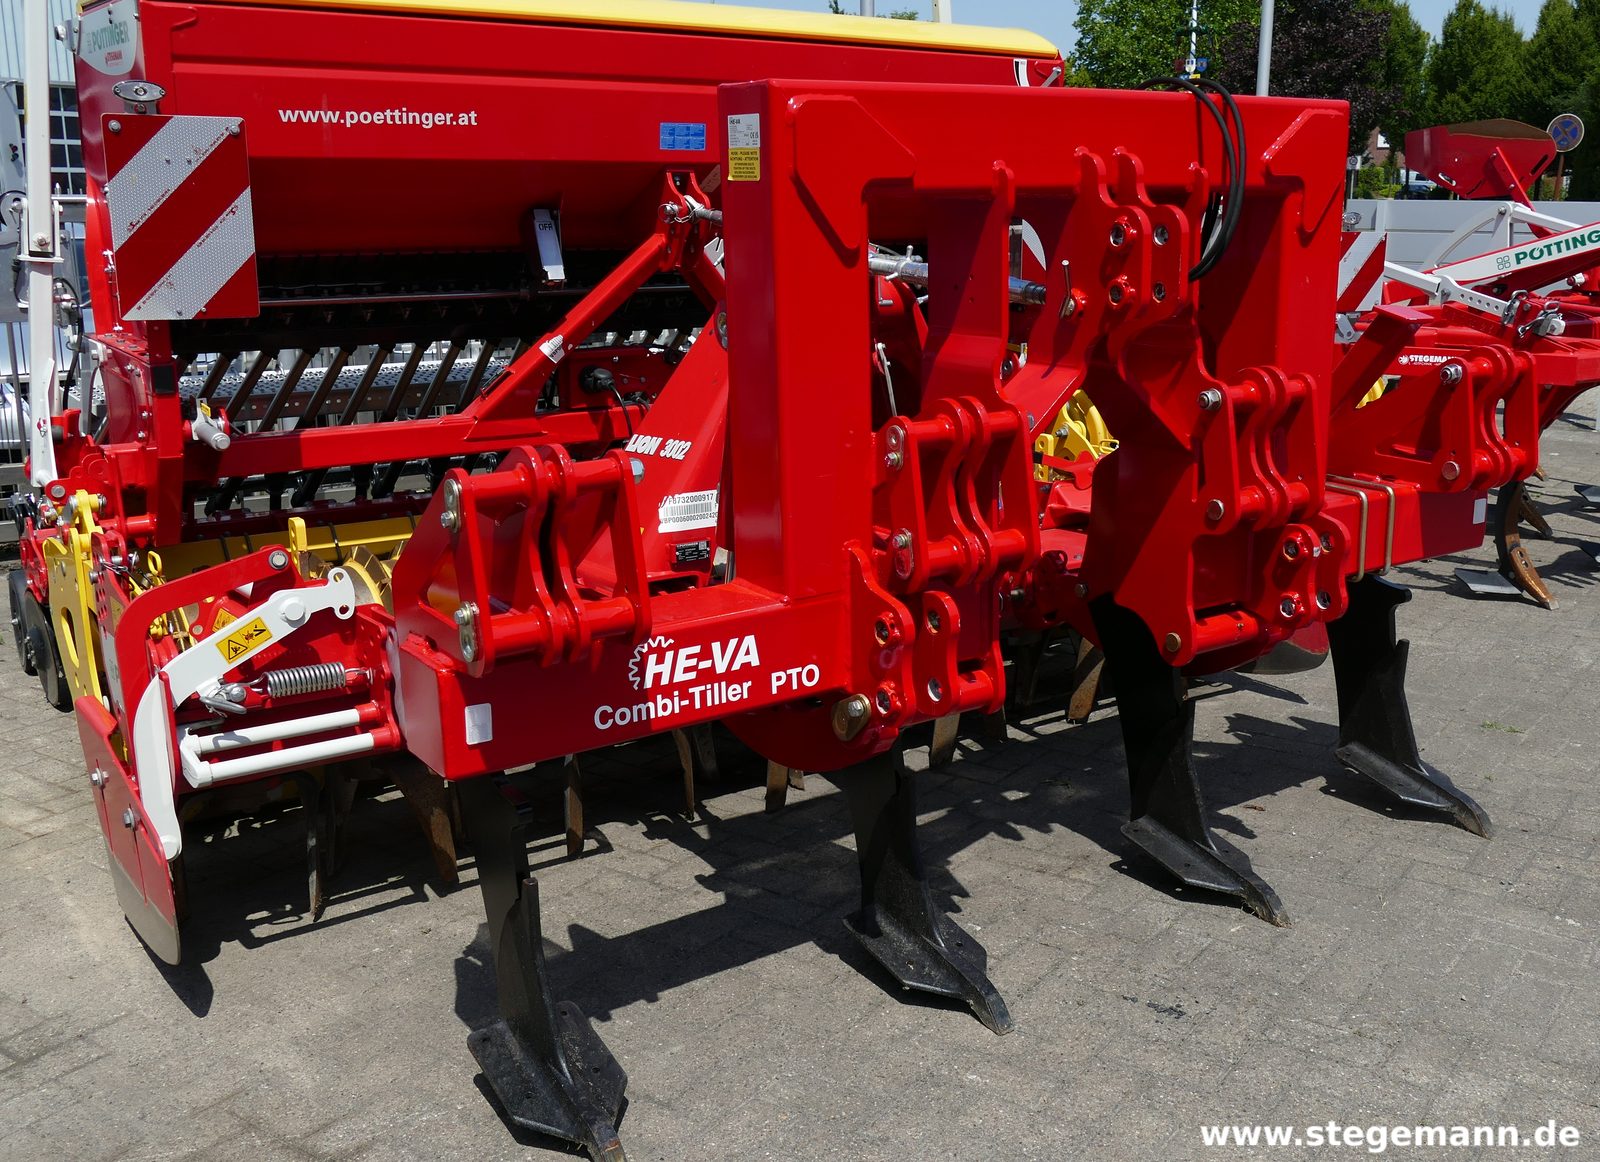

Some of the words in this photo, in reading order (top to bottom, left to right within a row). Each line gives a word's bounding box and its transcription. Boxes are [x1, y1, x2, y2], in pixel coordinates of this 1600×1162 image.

[278, 107, 478, 129] www.poettinger.at
[538, 223, 553, 231] OFF
[625, 434, 663, 456] LION
[660, 439, 692, 460] 3002
[643, 634, 760, 690] HE-VA
[594, 680, 752, 730] Combi-Tiller
[771, 663, 820, 695] PTO
